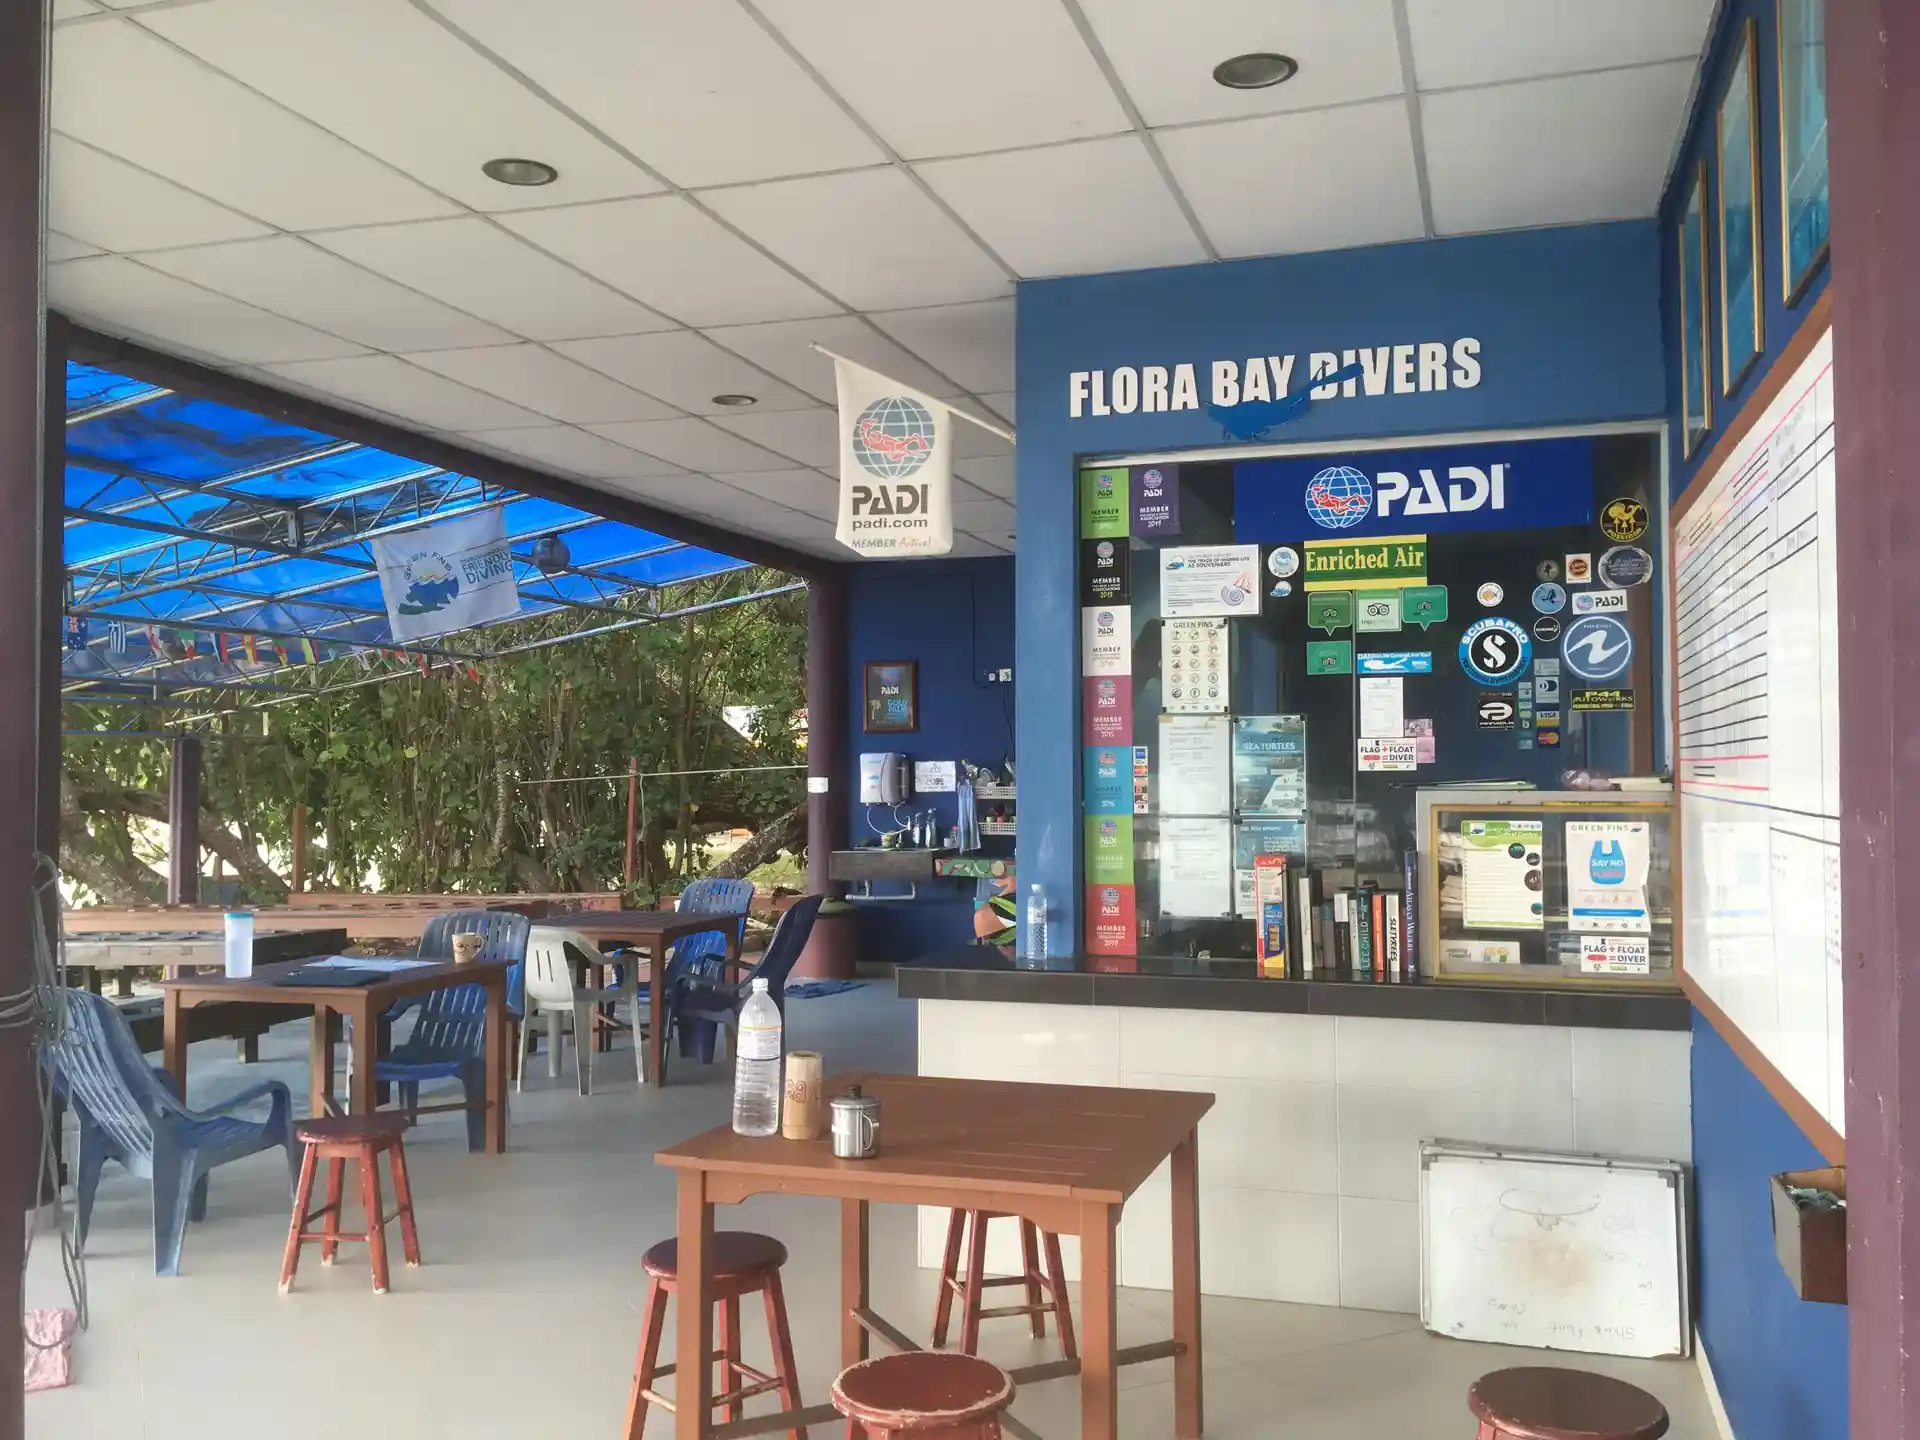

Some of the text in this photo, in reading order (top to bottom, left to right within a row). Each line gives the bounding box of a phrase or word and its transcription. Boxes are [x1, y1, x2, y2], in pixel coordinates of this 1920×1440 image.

[1070, 337, 1482, 418] FLORA BAY DIVERS
[1097, 489, 1114, 498] PADI
[1143, 489, 1164, 498] PADI
[1376, 463, 1505, 517] PADI
[852, 484, 929, 516] PADI
[1139, 505, 1170, 514] MEMBER
[852, 516, 930, 532] padi.com
[1606, 526, 1643, 541] POSEIDON
[851, 538, 897, 550] MEMBER
[462, 550, 513, 573] FRIENDLY
[1305, 545, 1425, 572] Enriched Air
[465, 561, 515, 585] DIVING
[1092, 577, 1121, 585] MEMBER
[1595, 595, 1623, 608] PADI
[1173, 620, 1214, 629] GREEN FINS
[1097, 627, 1114, 635] PADI
[1461, 619, 1528, 645] SCUBAPRO
[882, 686, 899, 695] PADI
[1540, 711, 1557, 719] VISA
[1243, 741, 1296, 751] SEA TURTLES
[1591, 859, 1624, 867] SAY NO
[1405, 890, 1415, 912] ATLAS
[1102, 906, 1120, 914] PADI
[1096, 924, 1127, 933] MEMBER
[1360, 921, 1370, 950] CHILD
[1584, 946, 1608, 954] FLAG
[1617, 946, 1645, 954] FLOAT
[1617, 955, 1646, 963] DIVER
